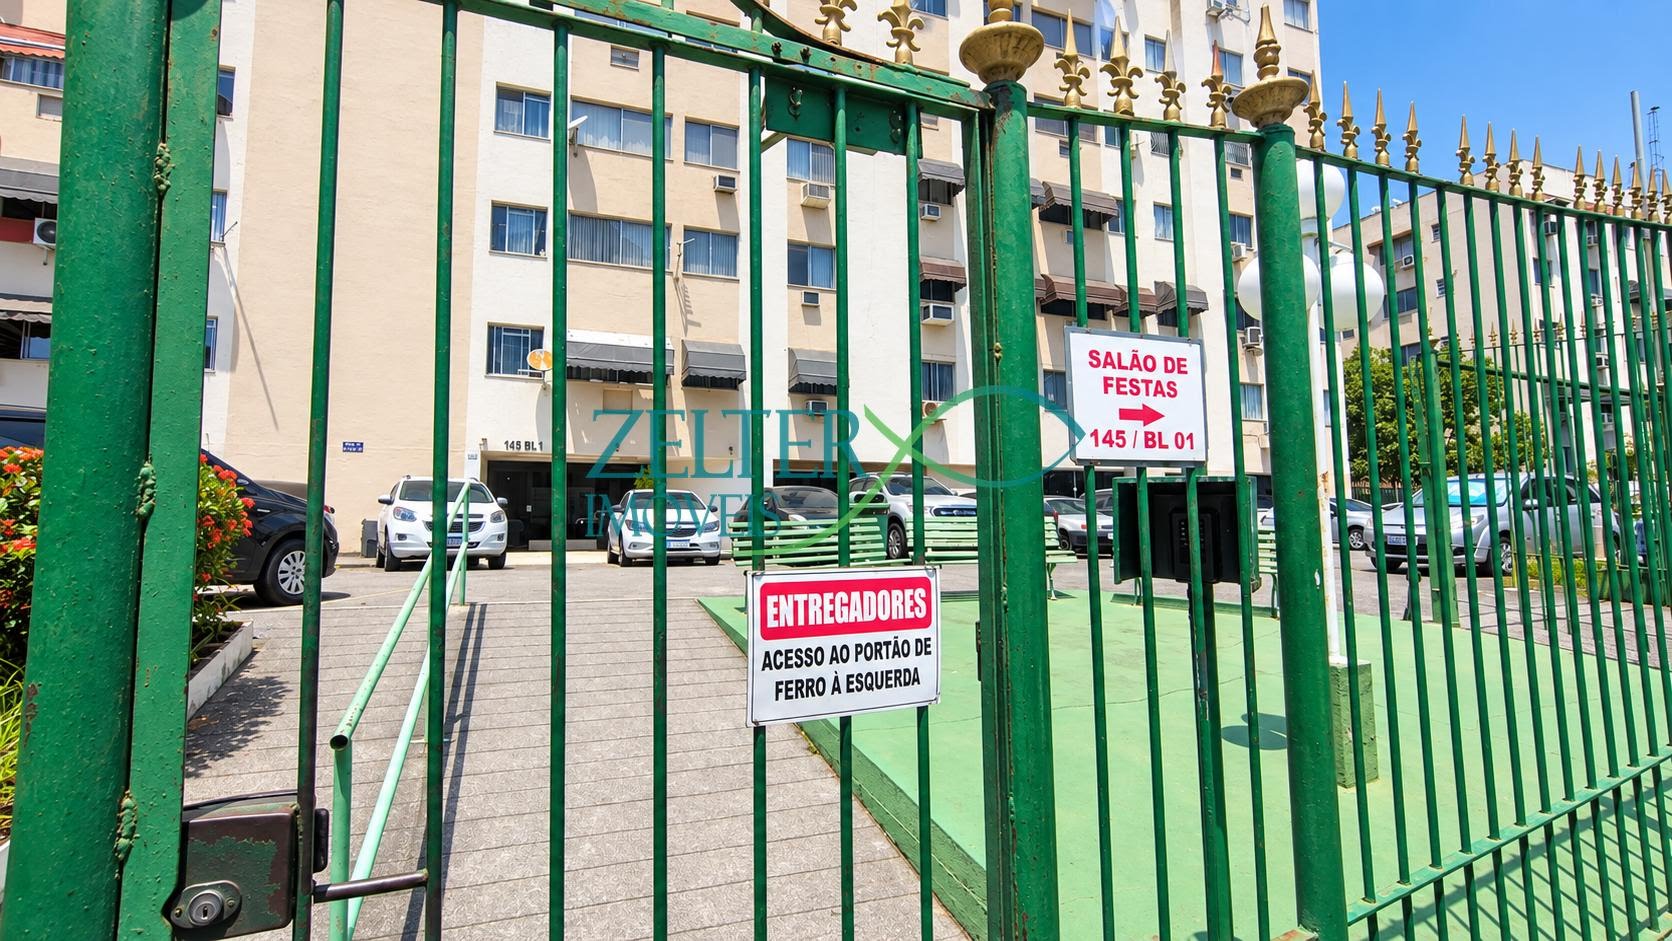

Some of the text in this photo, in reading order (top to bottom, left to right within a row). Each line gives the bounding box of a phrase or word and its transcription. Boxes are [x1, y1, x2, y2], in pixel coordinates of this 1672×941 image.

[1088, 349, 1188, 375] SALÃO DE
[1103, 376, 1178, 399] FESTAS
[504, 440, 543, 451] 145 BL 1
[1090, 428, 1194, 450] 145 / BL 01
[766, 588, 927, 628] ENTREGADORES
[761, 636, 932, 671] ACESSO AO PORTÃO DE
[775, 667, 921, 702] FERRO À ESQUERDA
